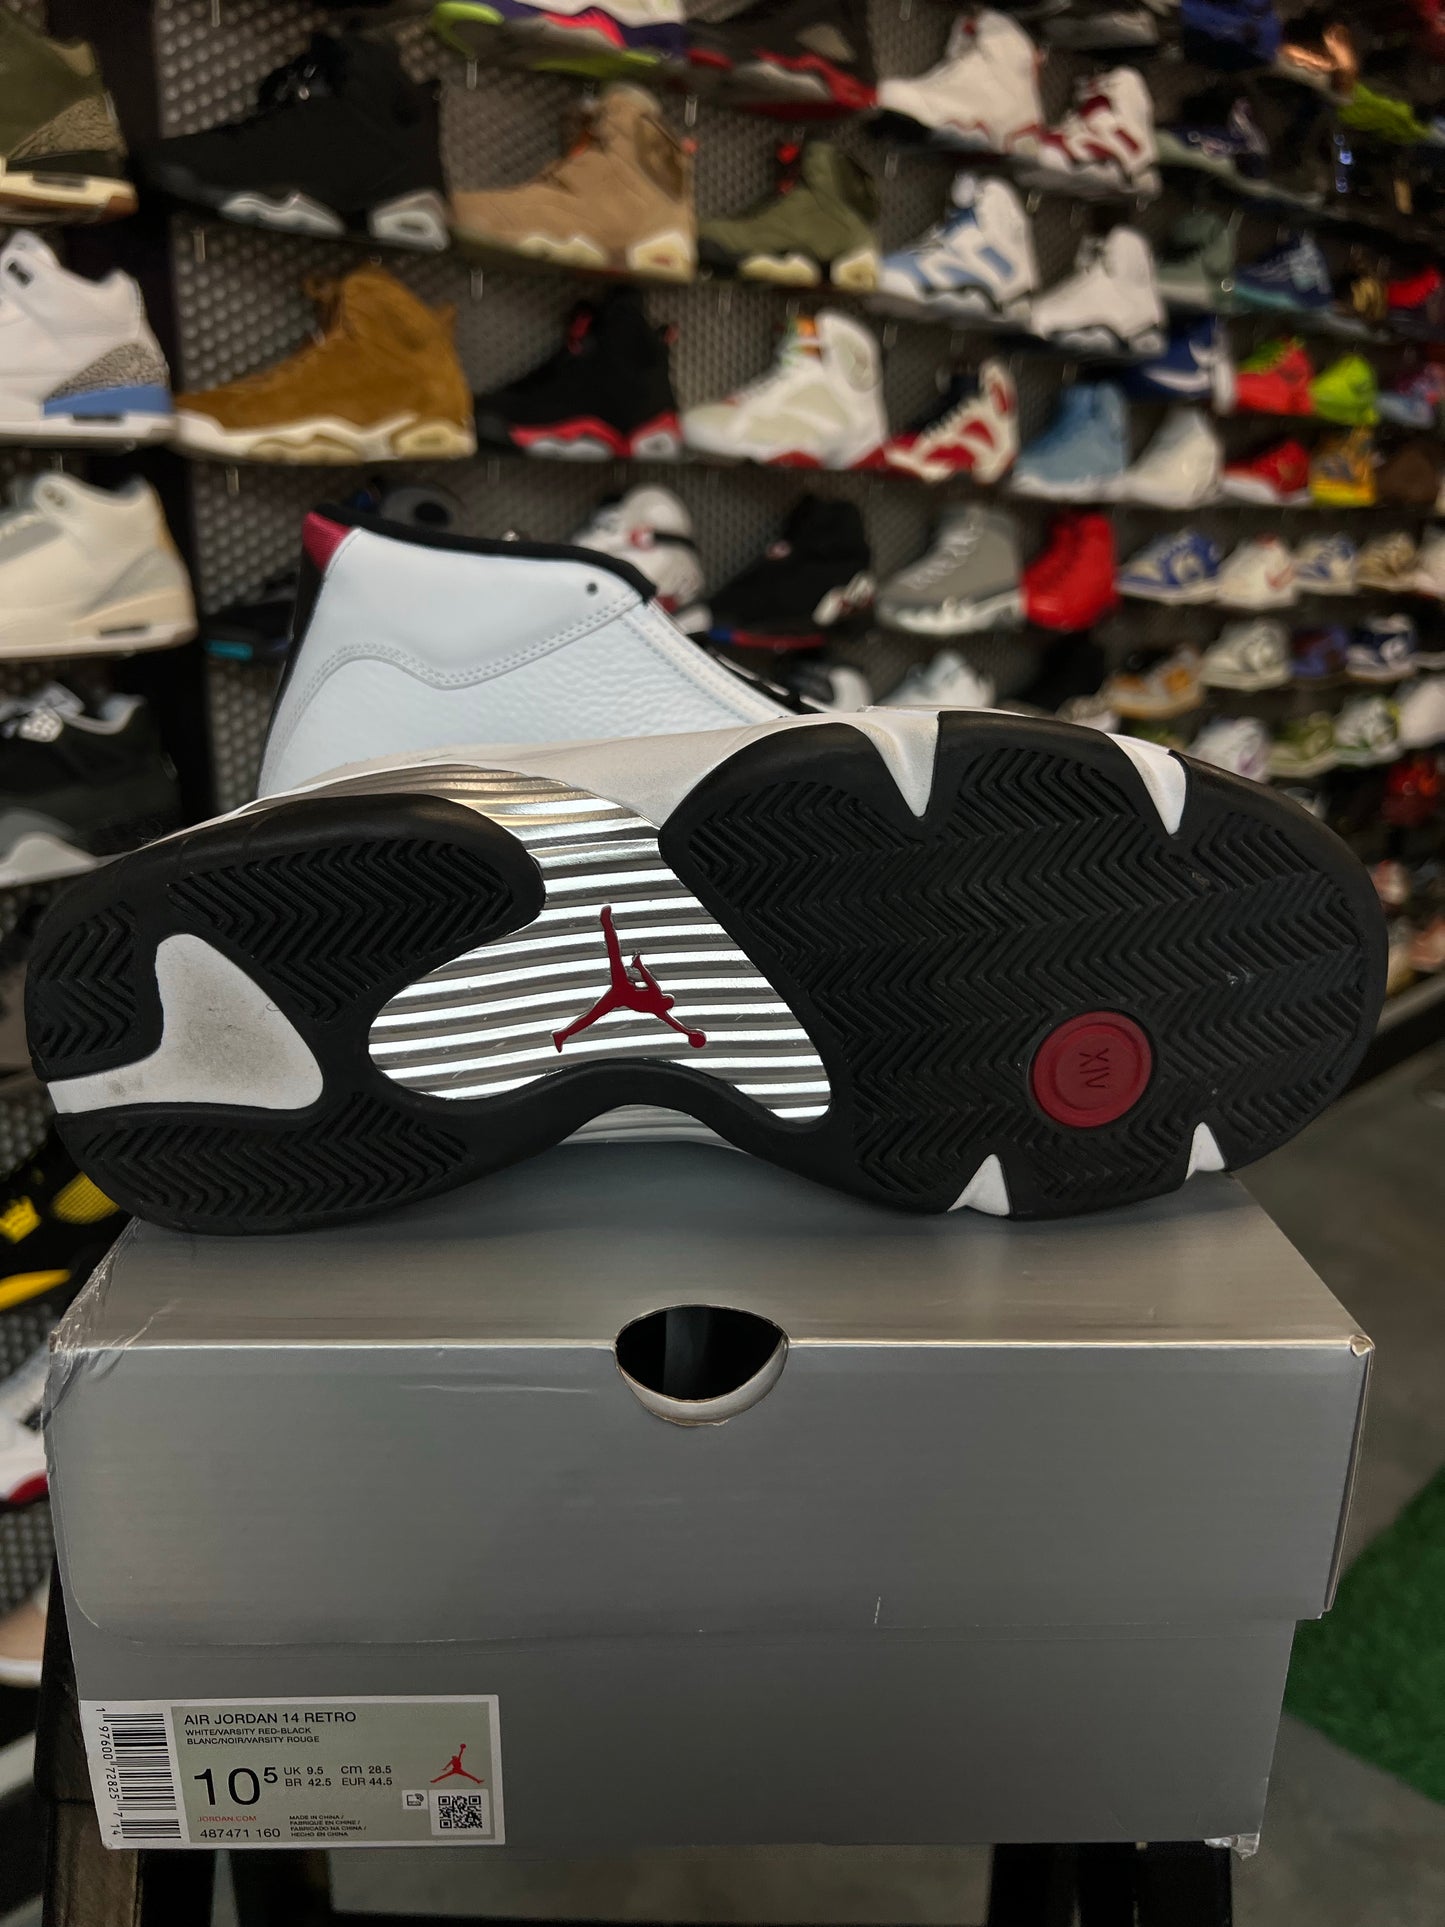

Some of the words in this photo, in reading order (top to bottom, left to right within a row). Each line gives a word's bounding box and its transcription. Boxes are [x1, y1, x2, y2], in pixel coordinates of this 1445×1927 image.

[1078, 1047, 1110, 1089] XIV
[184, 1714, 210, 1726] AIR
[214, 1713, 278, 1725] JORDAN
[282, 1712, 300, 1723] 14
[304, 1711, 357, 1723] RETRO
[185, 1728, 256, 1736] WHITE/VARSITY
[258, 1727, 312, 1735] RED-BLACK
[98, 1725, 114, 1760] 97600
[187, 1737, 284, 1745] BLANC/NOIR/VARSITY
[283, 1767, 301, 1775] UK
[306, 1767, 324, 1775] 9.5
[368, 1765, 392, 1774] 28.5
[105, 1767, 120, 1800] 72825
[285, 1778, 303, 1787] BR
[307, 1778, 332, 1787] 42.5
[341, 1777, 366, 1786] EUR
[368, 1777, 393, 1786] 44.5
[199, 1815, 257, 1823] JORDAN.COM
[200, 1828, 250, 1838] 487471
[256, 1828, 281, 1838] 160
